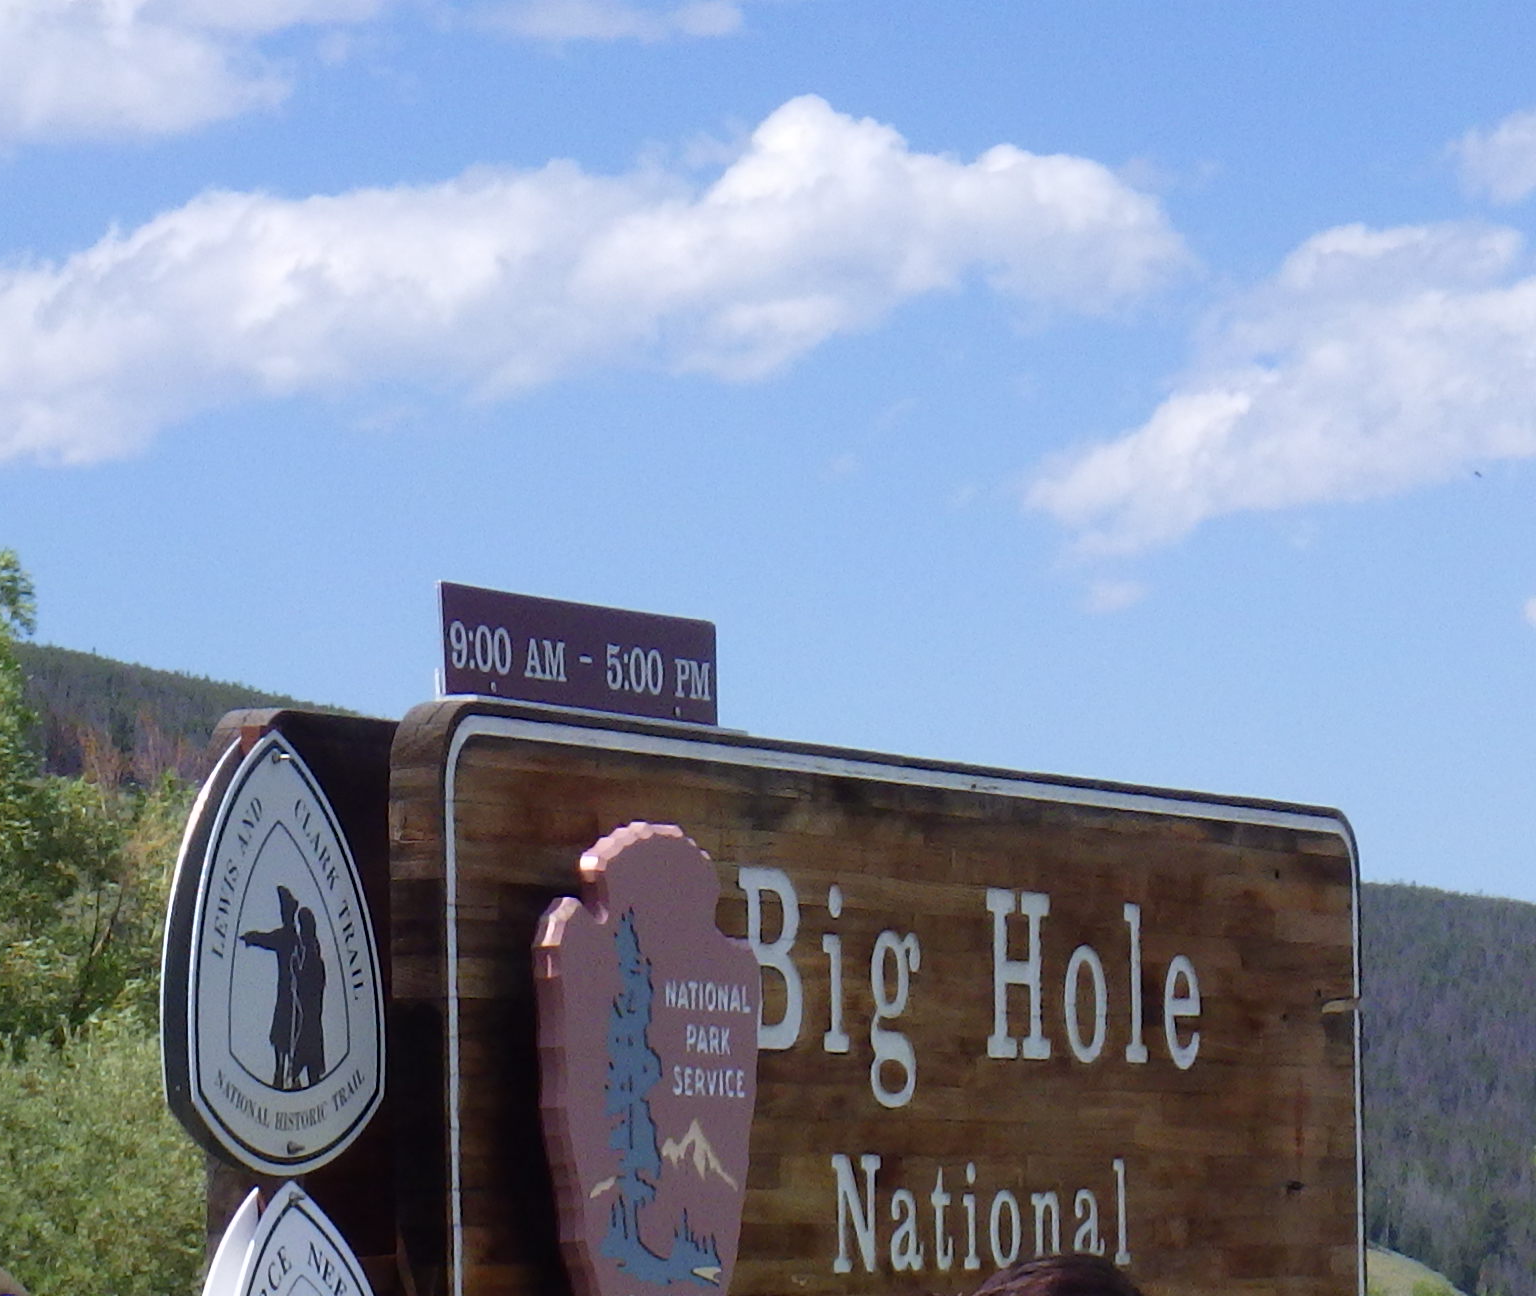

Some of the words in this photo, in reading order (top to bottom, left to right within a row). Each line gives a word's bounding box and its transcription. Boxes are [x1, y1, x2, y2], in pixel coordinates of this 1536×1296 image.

[449, 620, 512, 676] 9:00
[524, 637, 568, 682] AM
[606, 643, 664, 696] 5:00
[674, 658, 712, 701] PM
[211, 858, 240, 960] LEWIS
[237, 796, 263, 855] AND
[294, 798, 341, 891] CLARK
[338, 899, 364, 1001] TRAIL
[665, 979, 752, 1014] NATIONAL
[738, 866, 921, 1109] Big
[985, 886, 1202, 1071] Hole
[686, 1023, 732, 1056] PARK
[214, 1068, 271, 1130] NATIONAL
[274, 1101, 330, 1132] HISTORIC
[332, 1068, 367, 1113] TRAIL
[672, 1063, 746, 1098] SERVICE
[830, 1152, 1131, 1274] National
